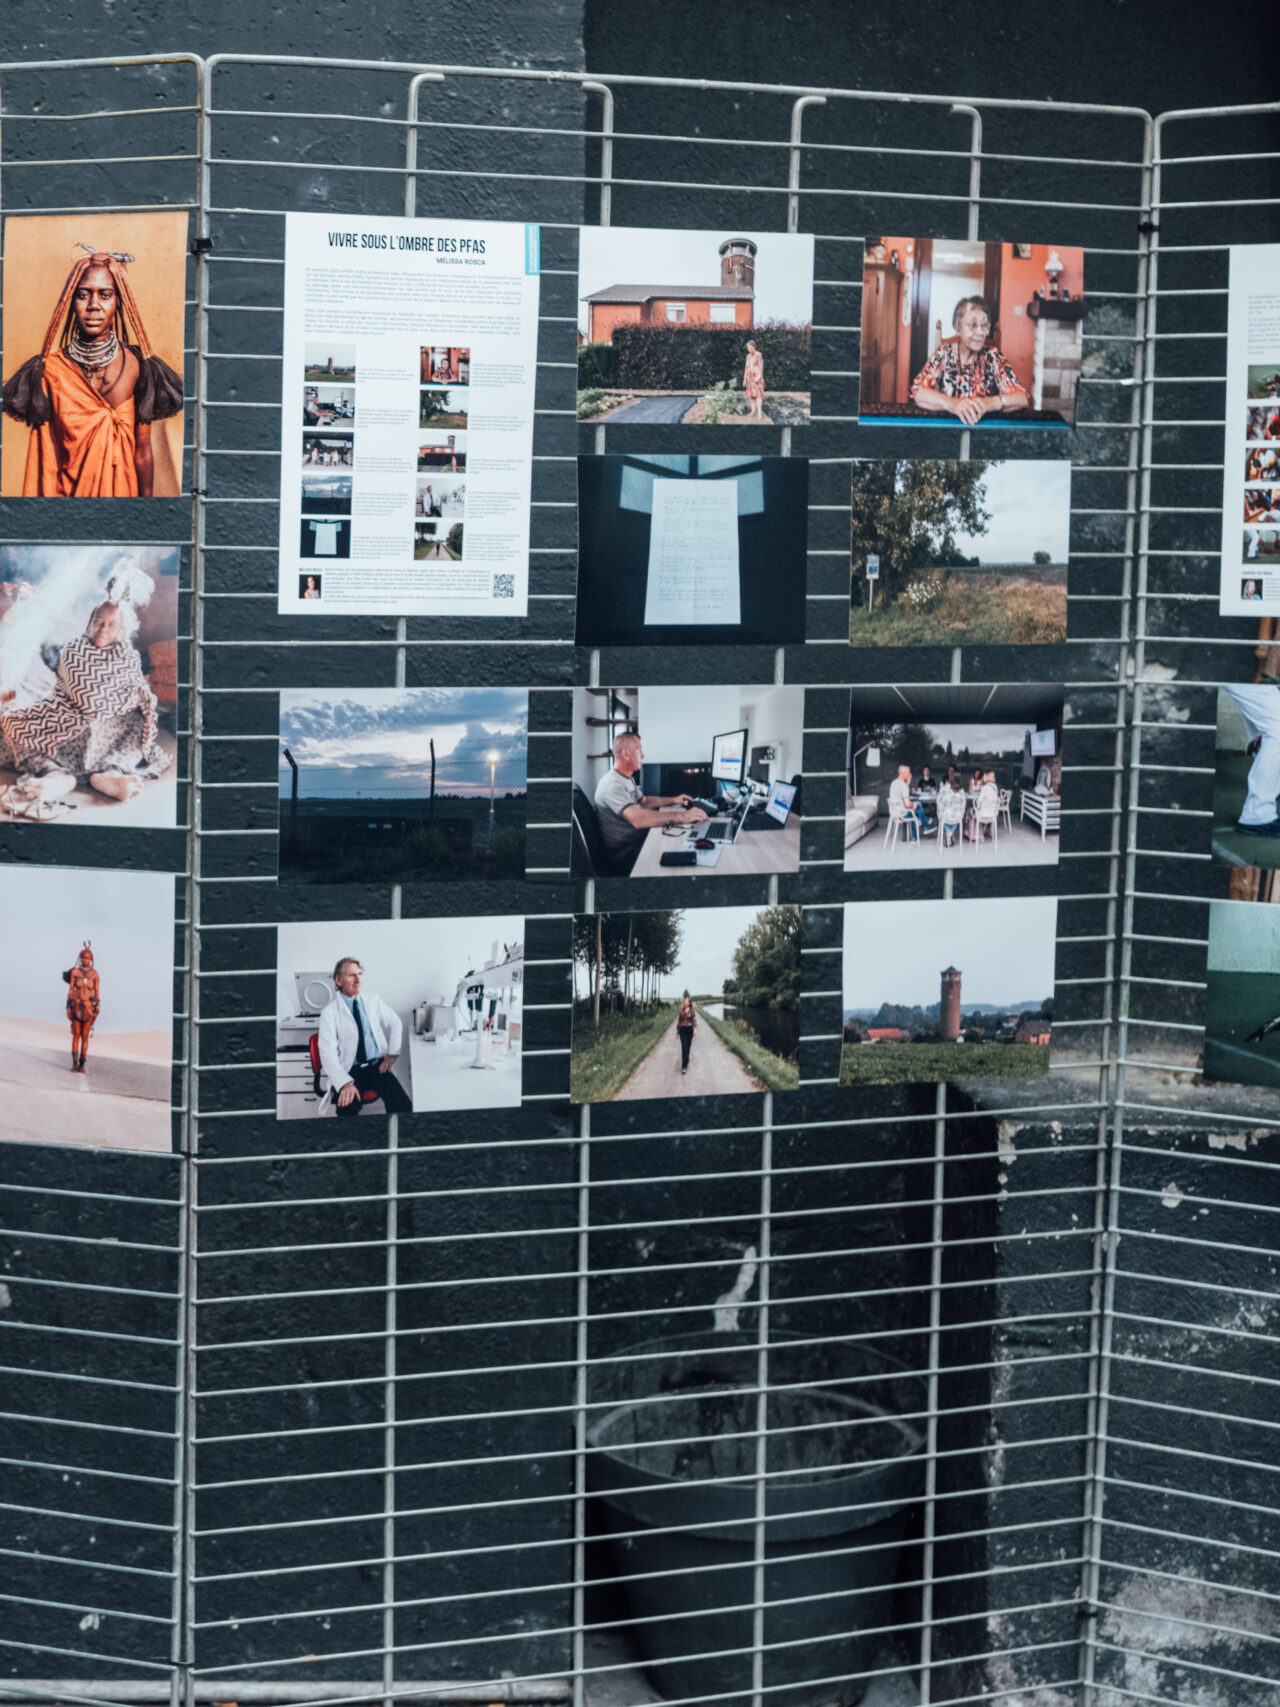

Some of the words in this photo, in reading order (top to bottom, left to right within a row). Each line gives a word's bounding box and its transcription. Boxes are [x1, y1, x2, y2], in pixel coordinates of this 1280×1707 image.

[328, 231, 358, 248] VIVRE
[361, 234, 387, 250] SOUS
[390, 235, 434, 252] L'OMBRE
[438, 237, 457, 253] DES
[460, 239, 486, 254] PFAS
[436, 256, 463, 265] MÉLISSA
[464, 258, 486, 266] ROSCA
